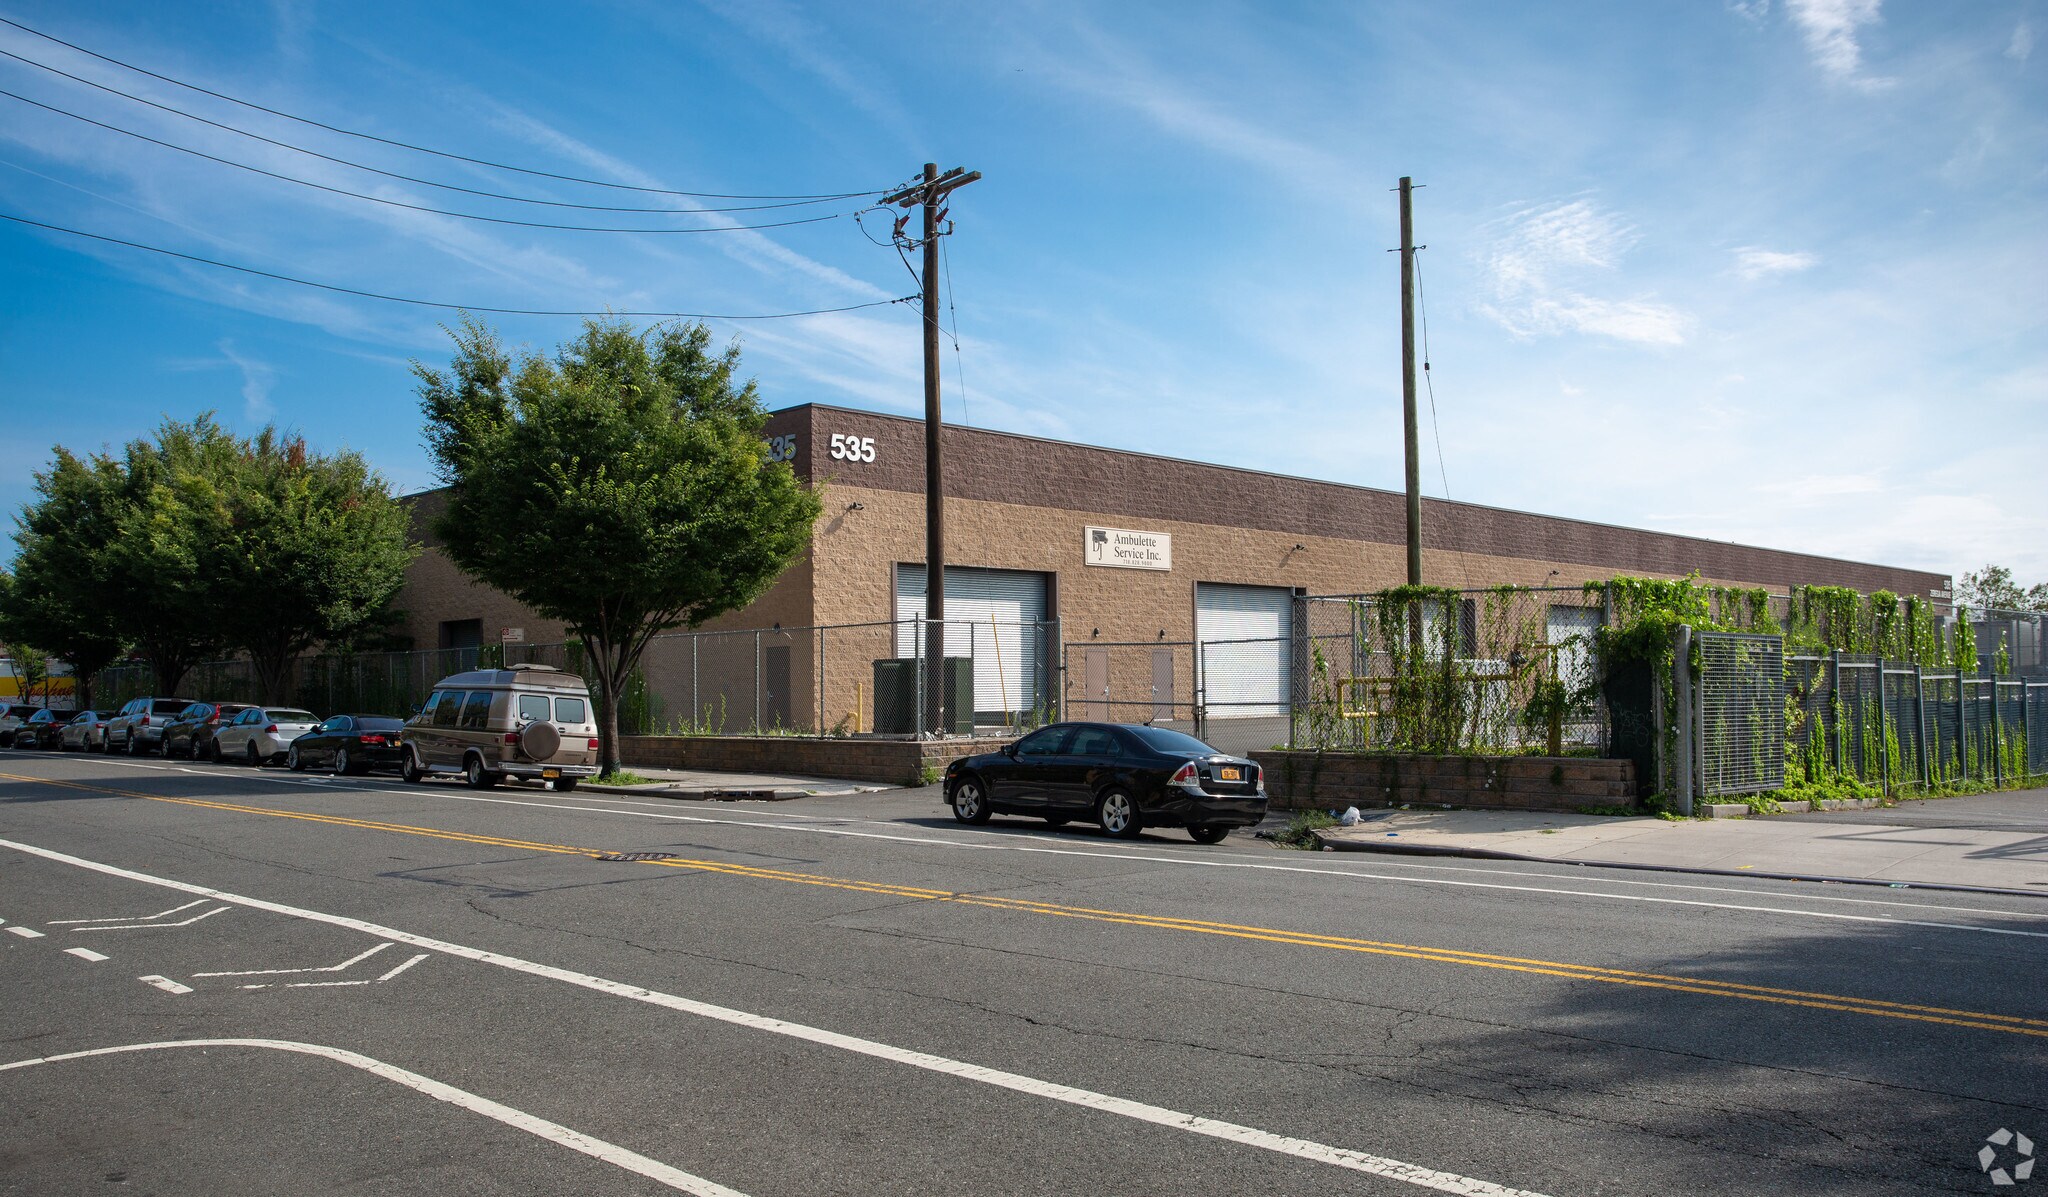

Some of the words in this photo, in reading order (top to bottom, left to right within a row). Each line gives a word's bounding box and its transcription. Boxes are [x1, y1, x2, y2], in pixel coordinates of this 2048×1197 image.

[830, 433, 876, 463] 535
[1114, 533, 1157, 548] Ambulette
[1114, 546, 1144, 559] Service
[1146, 549, 1162, 561] Inc.
